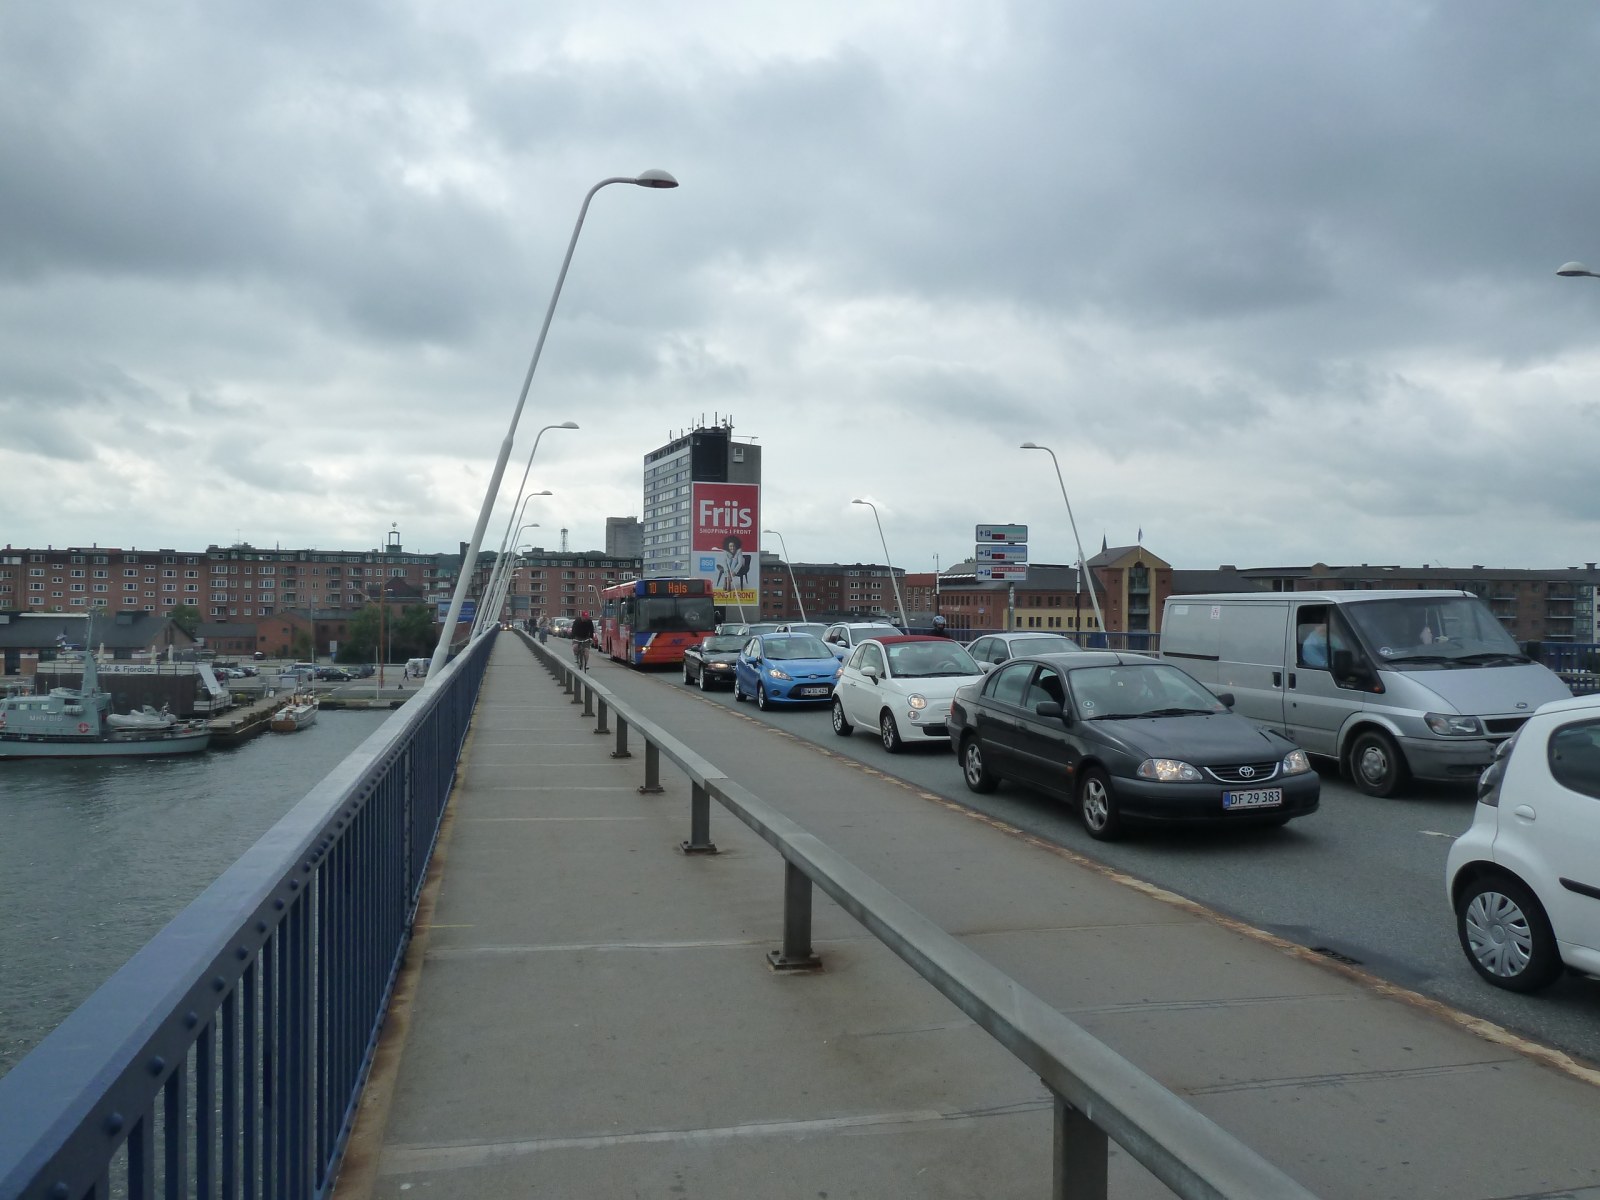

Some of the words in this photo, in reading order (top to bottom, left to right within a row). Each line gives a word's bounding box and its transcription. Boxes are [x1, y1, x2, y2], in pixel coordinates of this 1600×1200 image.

[700, 499, 752, 528] Friis
[667, 582, 688, 594] Hals
[114, 665, 120, 673] &
[123, 665, 155, 675] Fjordbar
[1230, 793, 1244, 805] DF
[1247, 792, 1260, 804] 29
[1261, 791, 1280, 803] 383
